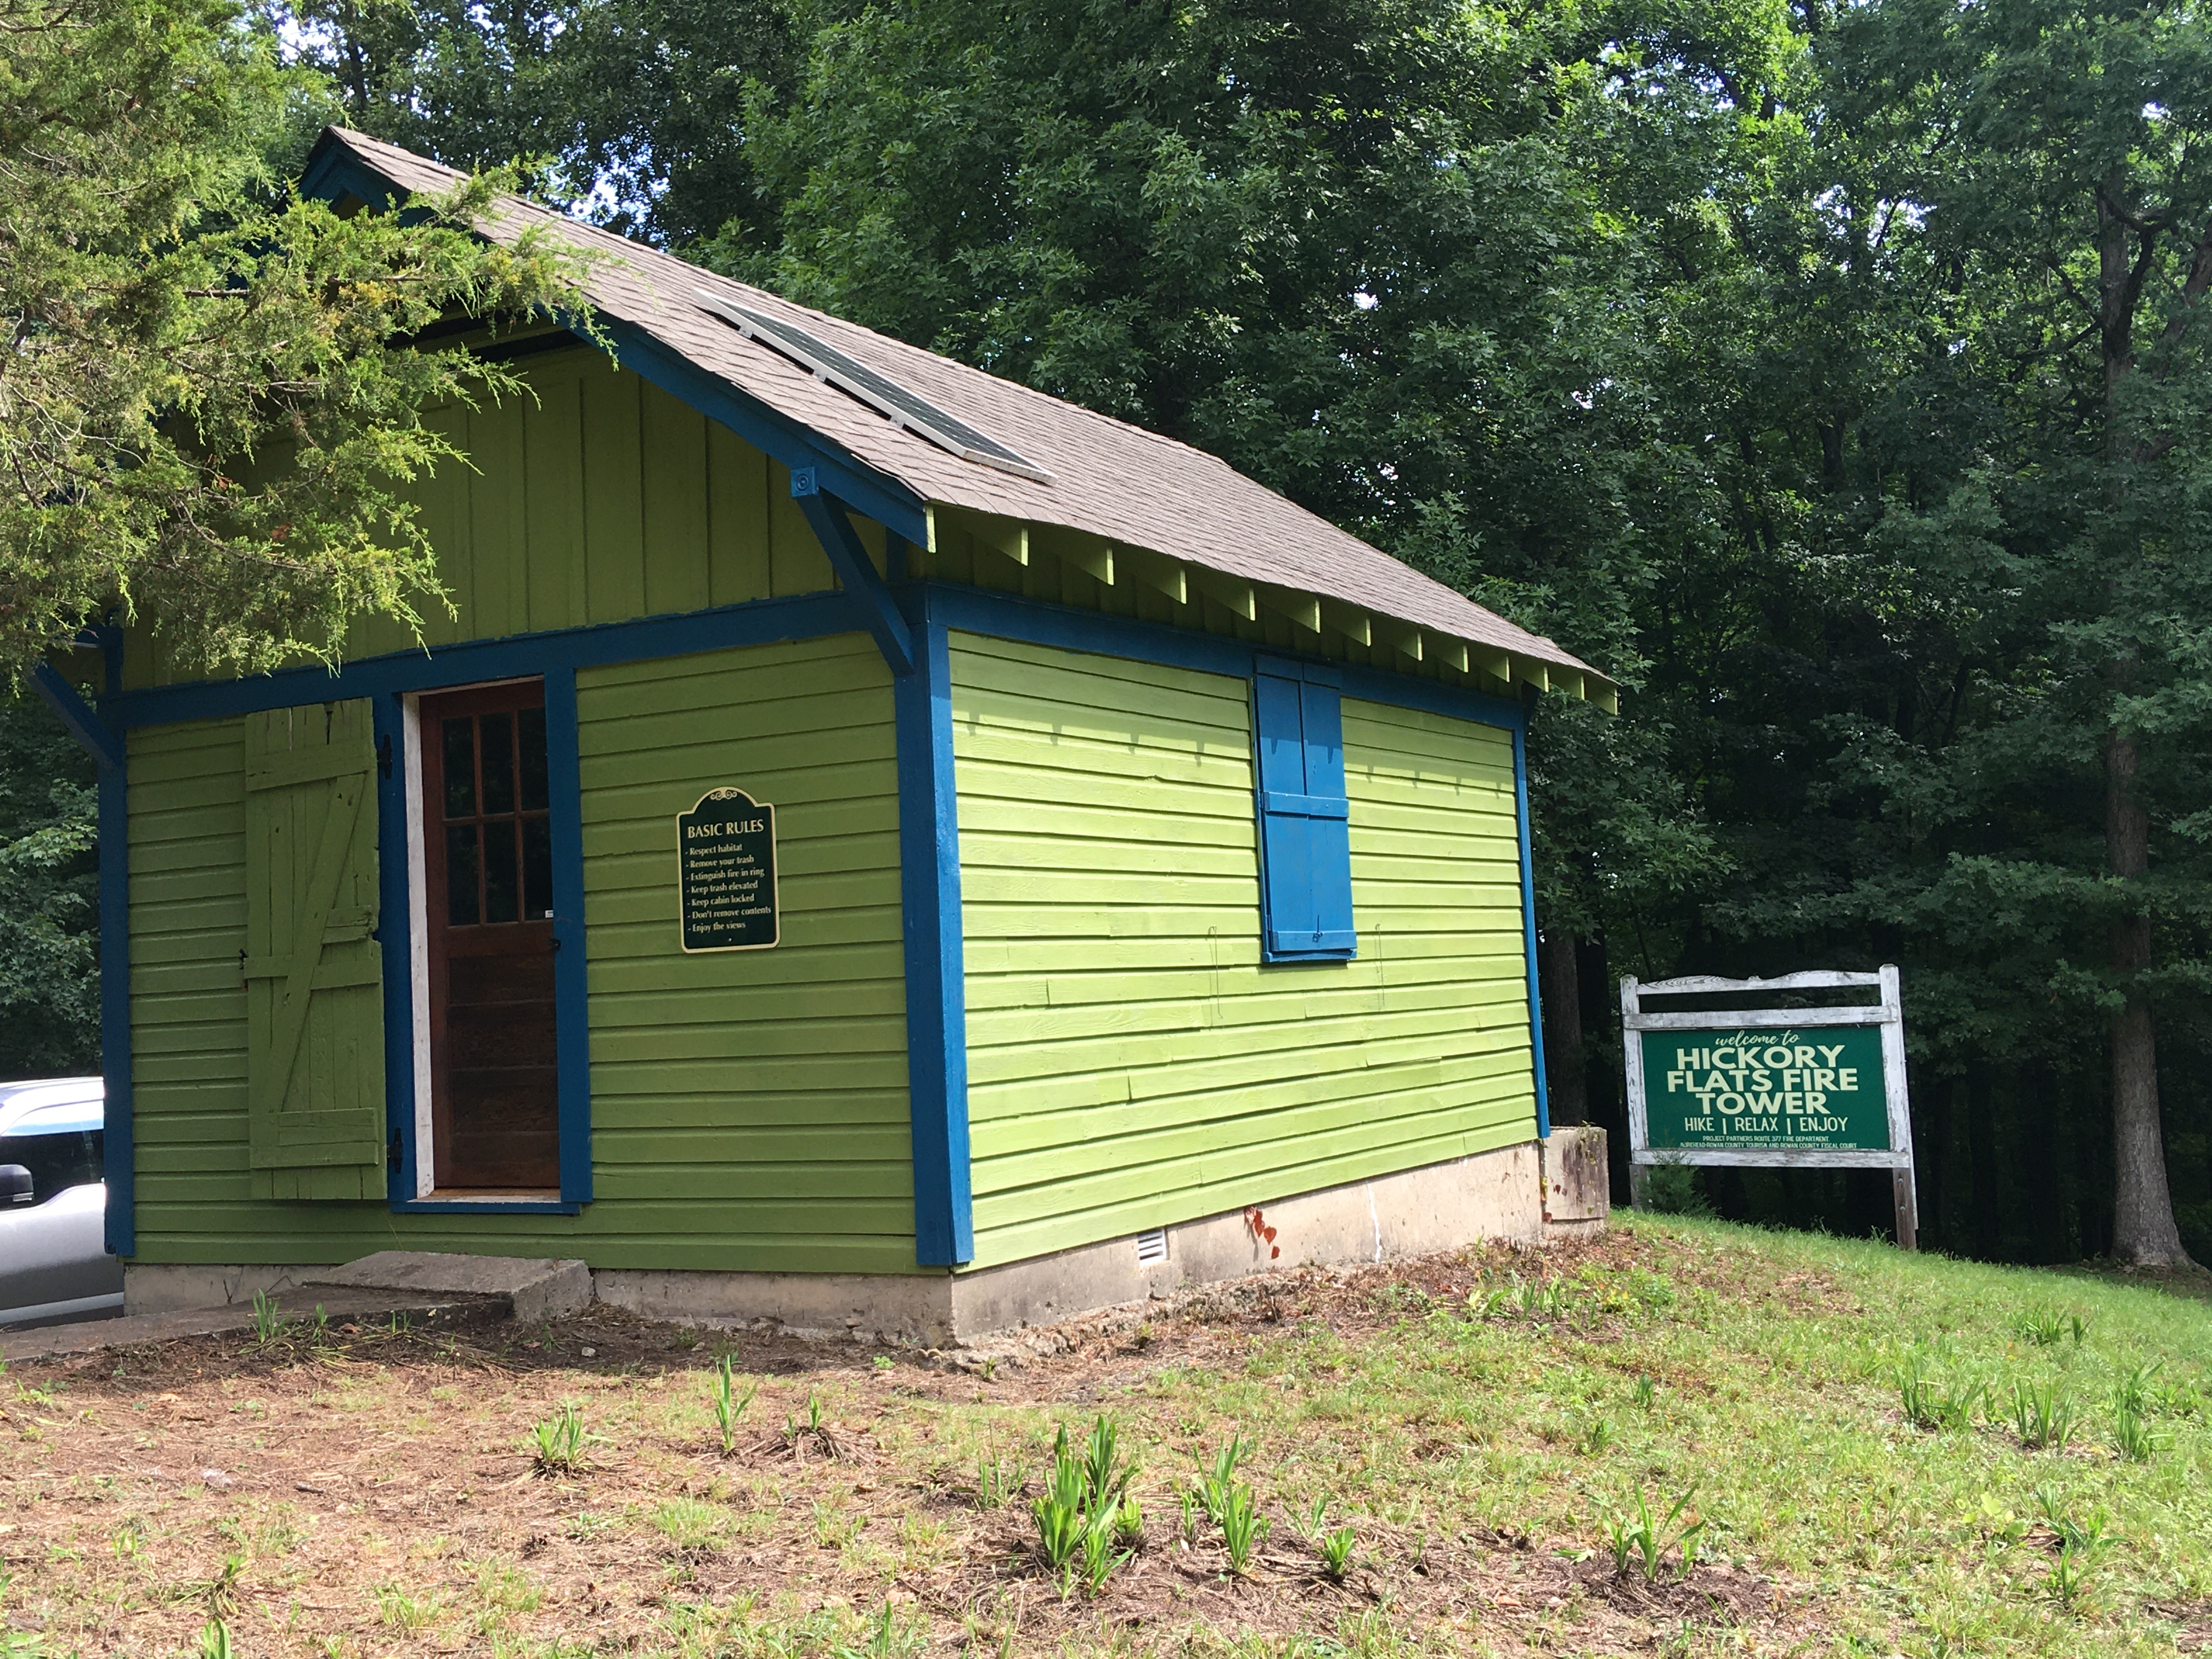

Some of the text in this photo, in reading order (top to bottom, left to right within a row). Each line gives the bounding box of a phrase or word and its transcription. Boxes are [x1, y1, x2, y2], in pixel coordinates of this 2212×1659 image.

[688, 819, 764, 838] BASIC RULES
[690, 846, 716, 856] Respect
[718, 843, 743, 853] habitat
[719, 858, 735, 867] your
[736, 854, 754, 864] trash
[691, 870, 726, 882] Extinguish
[727, 869, 740, 877] fire
[741, 868, 748, 876] in
[750, 867, 765, 877] ring
[691, 885, 708, 895] Keep
[710, 883, 727, 892] trash
[729, 879, 758, 890] elevated
[692, 898, 709, 907] Keep
[710, 895, 730, 905] cabin
[731, 893, 755, 902] locked
[692, 910, 712, 919] Don't
[741, 906, 771, 915] contents
[692, 922, 712, 933] Enjoy
[713, 921, 724, 930] the
[1715, 1029, 1799, 1047] welcome to
[1677, 1045, 1845, 1070] HICKORY
[1667, 1068, 1858, 1092] FLATS FIRE
[1695, 1092, 1831, 1114] TOWER
[1685, 1117, 1714, 1131] HIKE
[1735, 1117, 1779, 1131] RELAX
[1799, 1117, 1848, 1132] ENJOY
